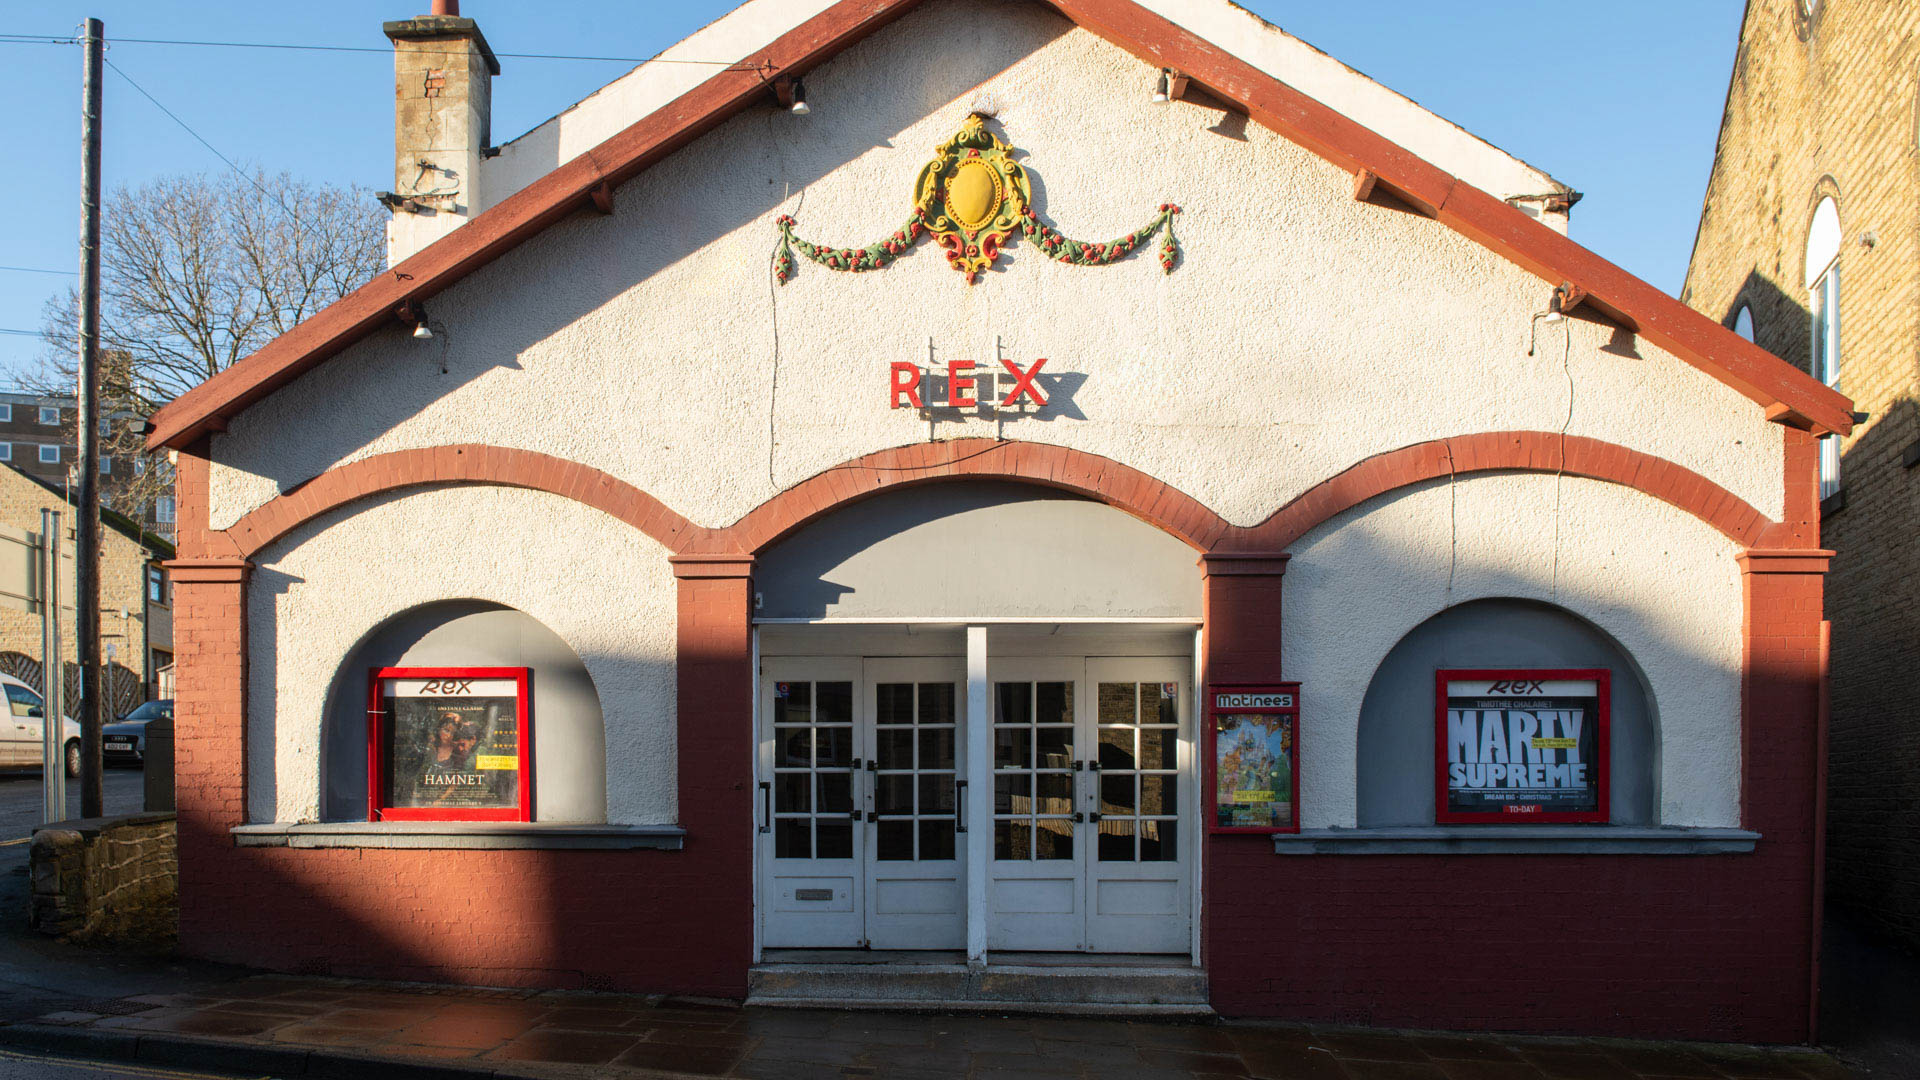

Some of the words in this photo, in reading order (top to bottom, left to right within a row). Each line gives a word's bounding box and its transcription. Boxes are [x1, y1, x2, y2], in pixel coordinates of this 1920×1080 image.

[891, 358, 1048, 409] REX
[419, 679, 475, 695] Rex
[1486, 680, 1545, 695] Rex
[1218, 694, 1291, 707] Matinees
[1448, 710, 1584, 764] MARTY
[424, 774, 485, 785] HAMNET
[1449, 763, 1588, 788] SUPREME
[1509, 805, 1536, 813] TO-DAY
